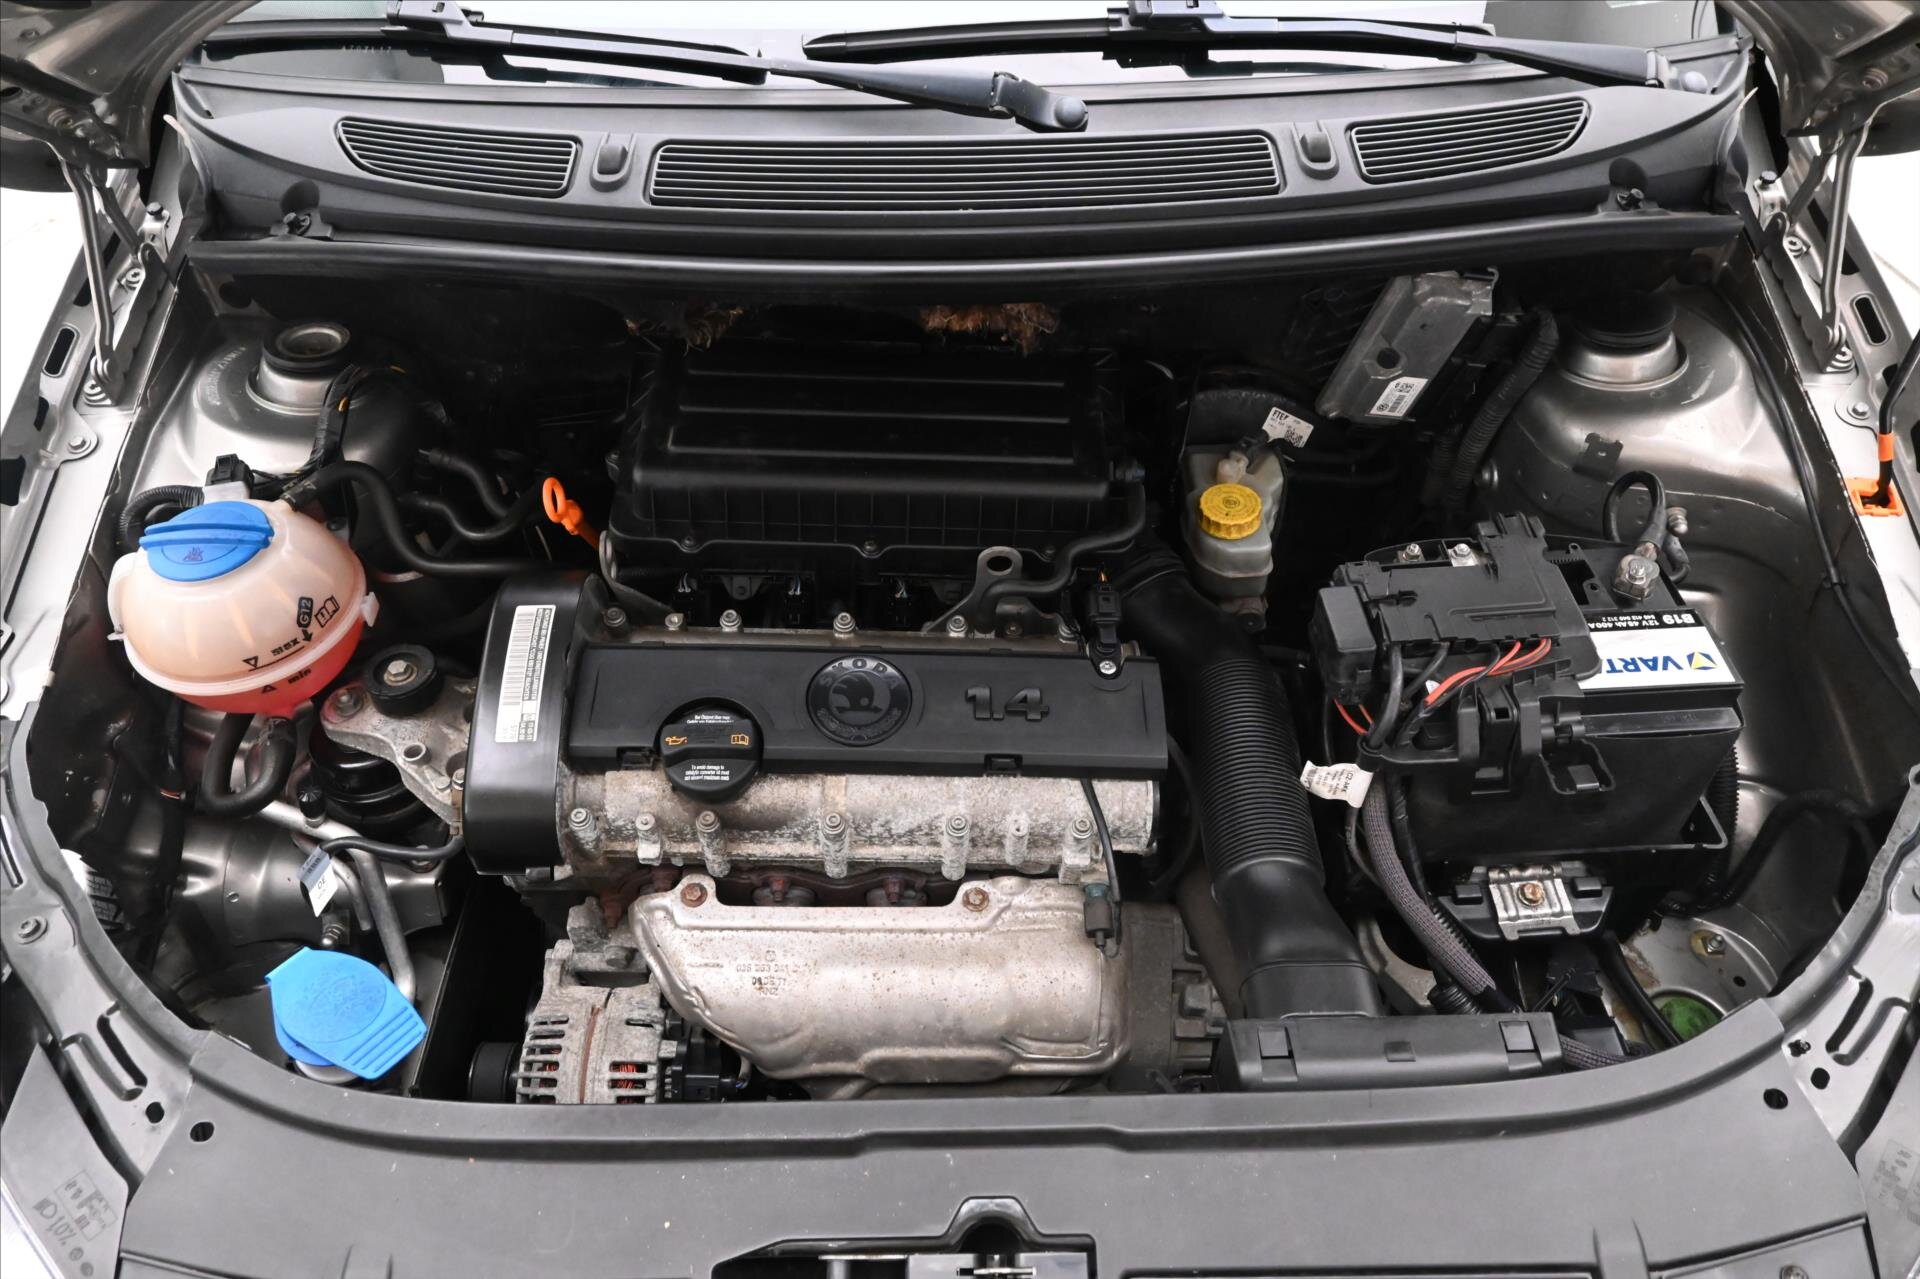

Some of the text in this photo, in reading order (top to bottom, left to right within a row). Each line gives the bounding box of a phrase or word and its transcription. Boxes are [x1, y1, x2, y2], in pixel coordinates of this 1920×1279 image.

[1662, 613, 1696, 625] B19
[1600, 654, 1684, 673] VART
[288, 668, 312, 684] min
[965, 687, 1050, 722] 1.4
